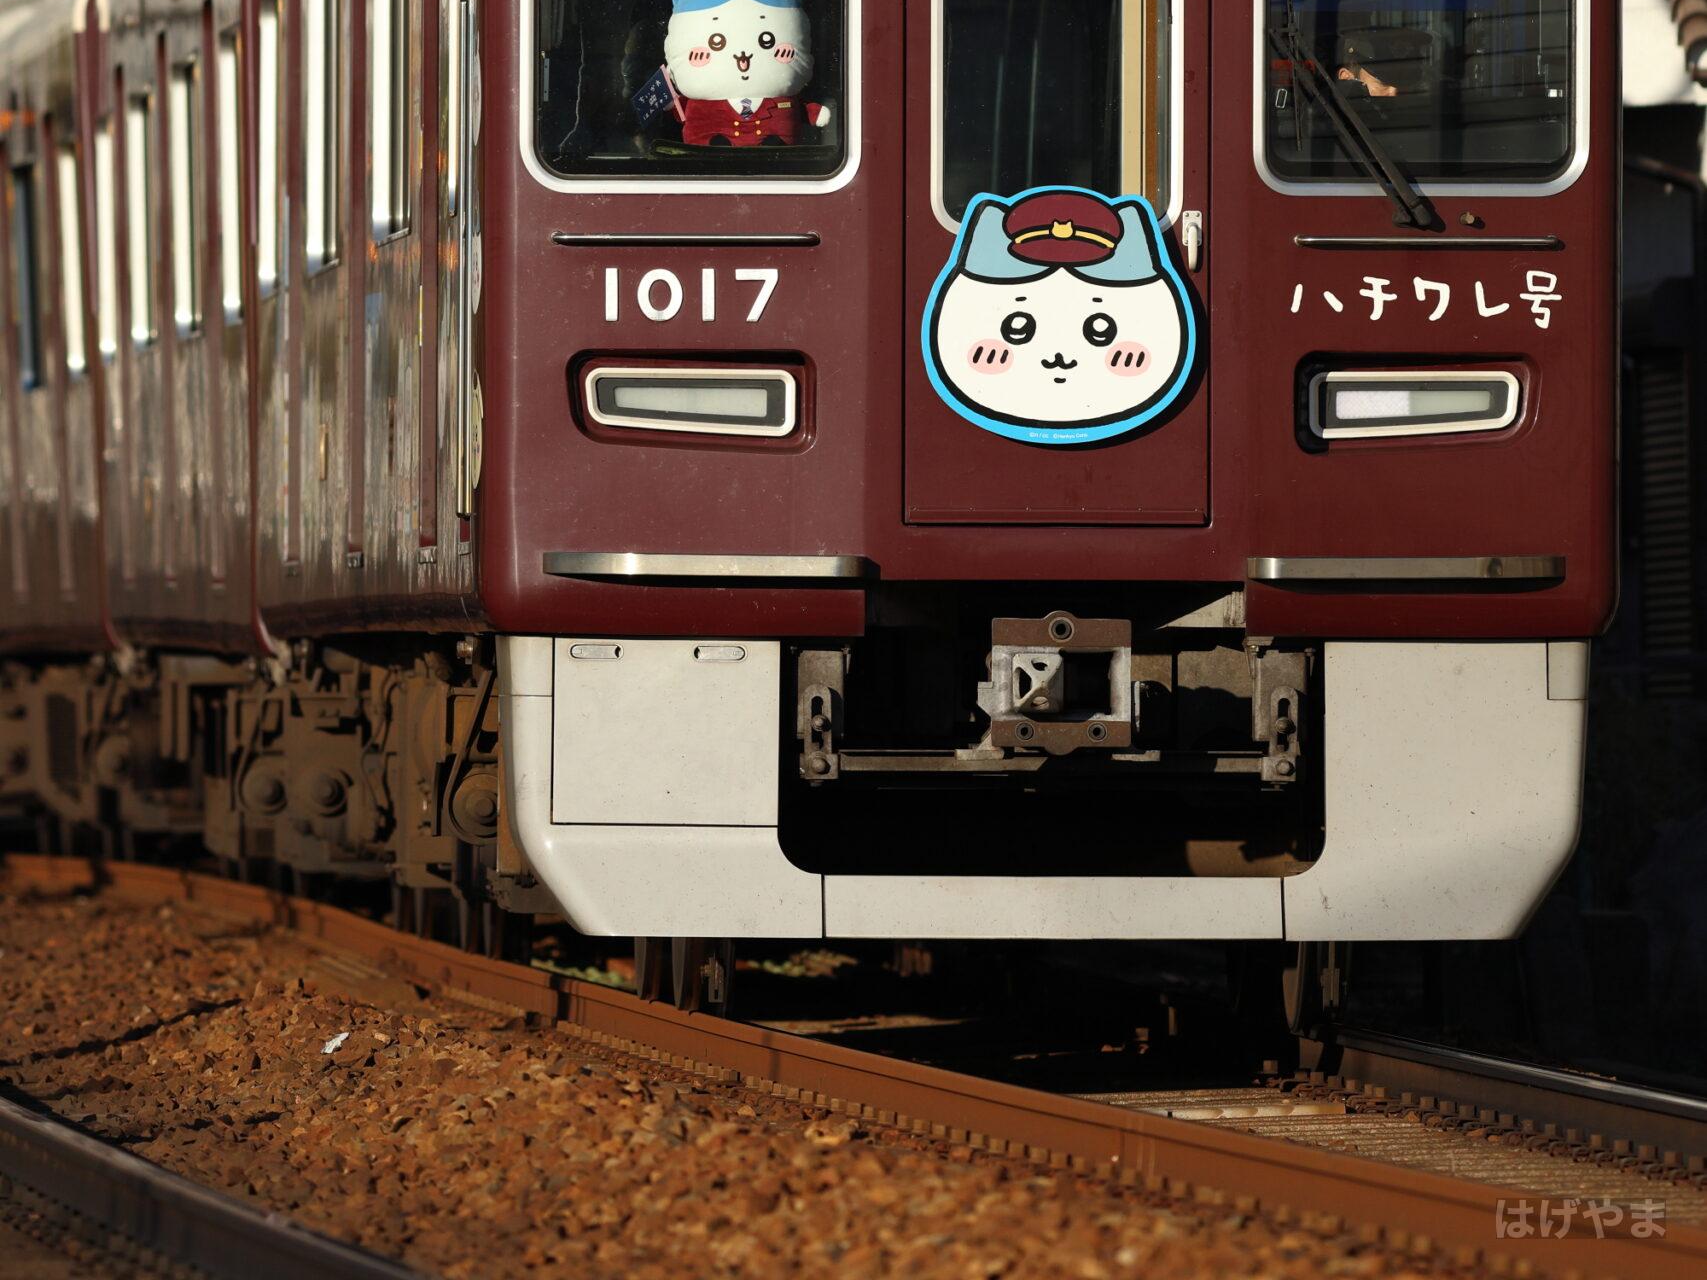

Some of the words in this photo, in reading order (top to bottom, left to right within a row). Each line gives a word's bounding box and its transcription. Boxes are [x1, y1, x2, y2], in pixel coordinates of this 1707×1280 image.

[605, 268, 778, 321] 1017
[1291, 270, 1562, 329] ハチワレ号
